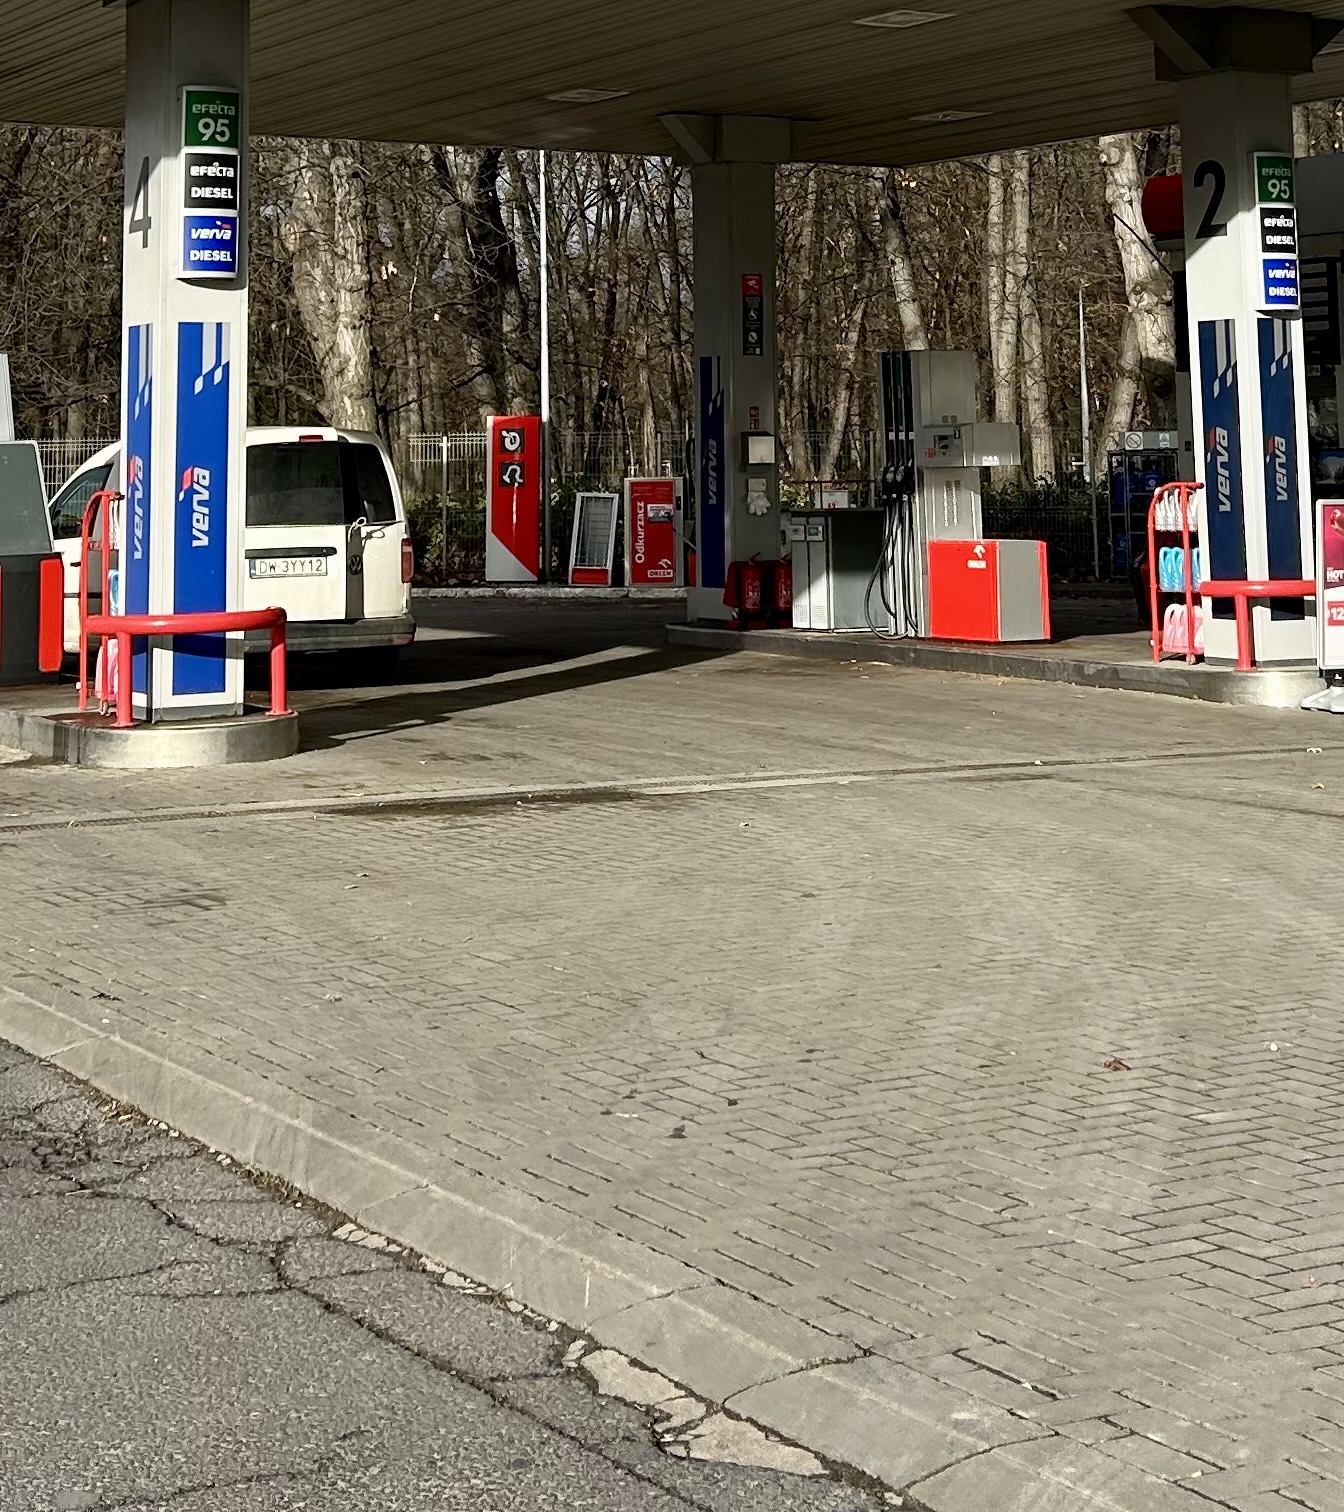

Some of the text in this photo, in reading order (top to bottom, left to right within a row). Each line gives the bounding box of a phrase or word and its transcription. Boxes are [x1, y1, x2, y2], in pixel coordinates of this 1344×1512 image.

[197, 117, 230, 143] 95
[191, 186, 233, 199] DIESEL
[1193, 160, 1228, 239] 2
[1267, 179, 1290, 199] 95
[129, 156, 152, 249] 4
[191, 223, 232, 240] verva
[1266, 235, 1295, 246] DIESEL
[189, 249, 232, 262] DIESEL
[1268, 287, 1298, 298] DIESEL
[1216, 426, 1232, 513] verva
[1273, 435, 1288, 502] verva
[133, 456, 144, 560] verva
[191, 466, 212, 548] verva
[635, 501, 645, 563] Odkurzacz
[259, 559, 323, 574] DW 3YY12
